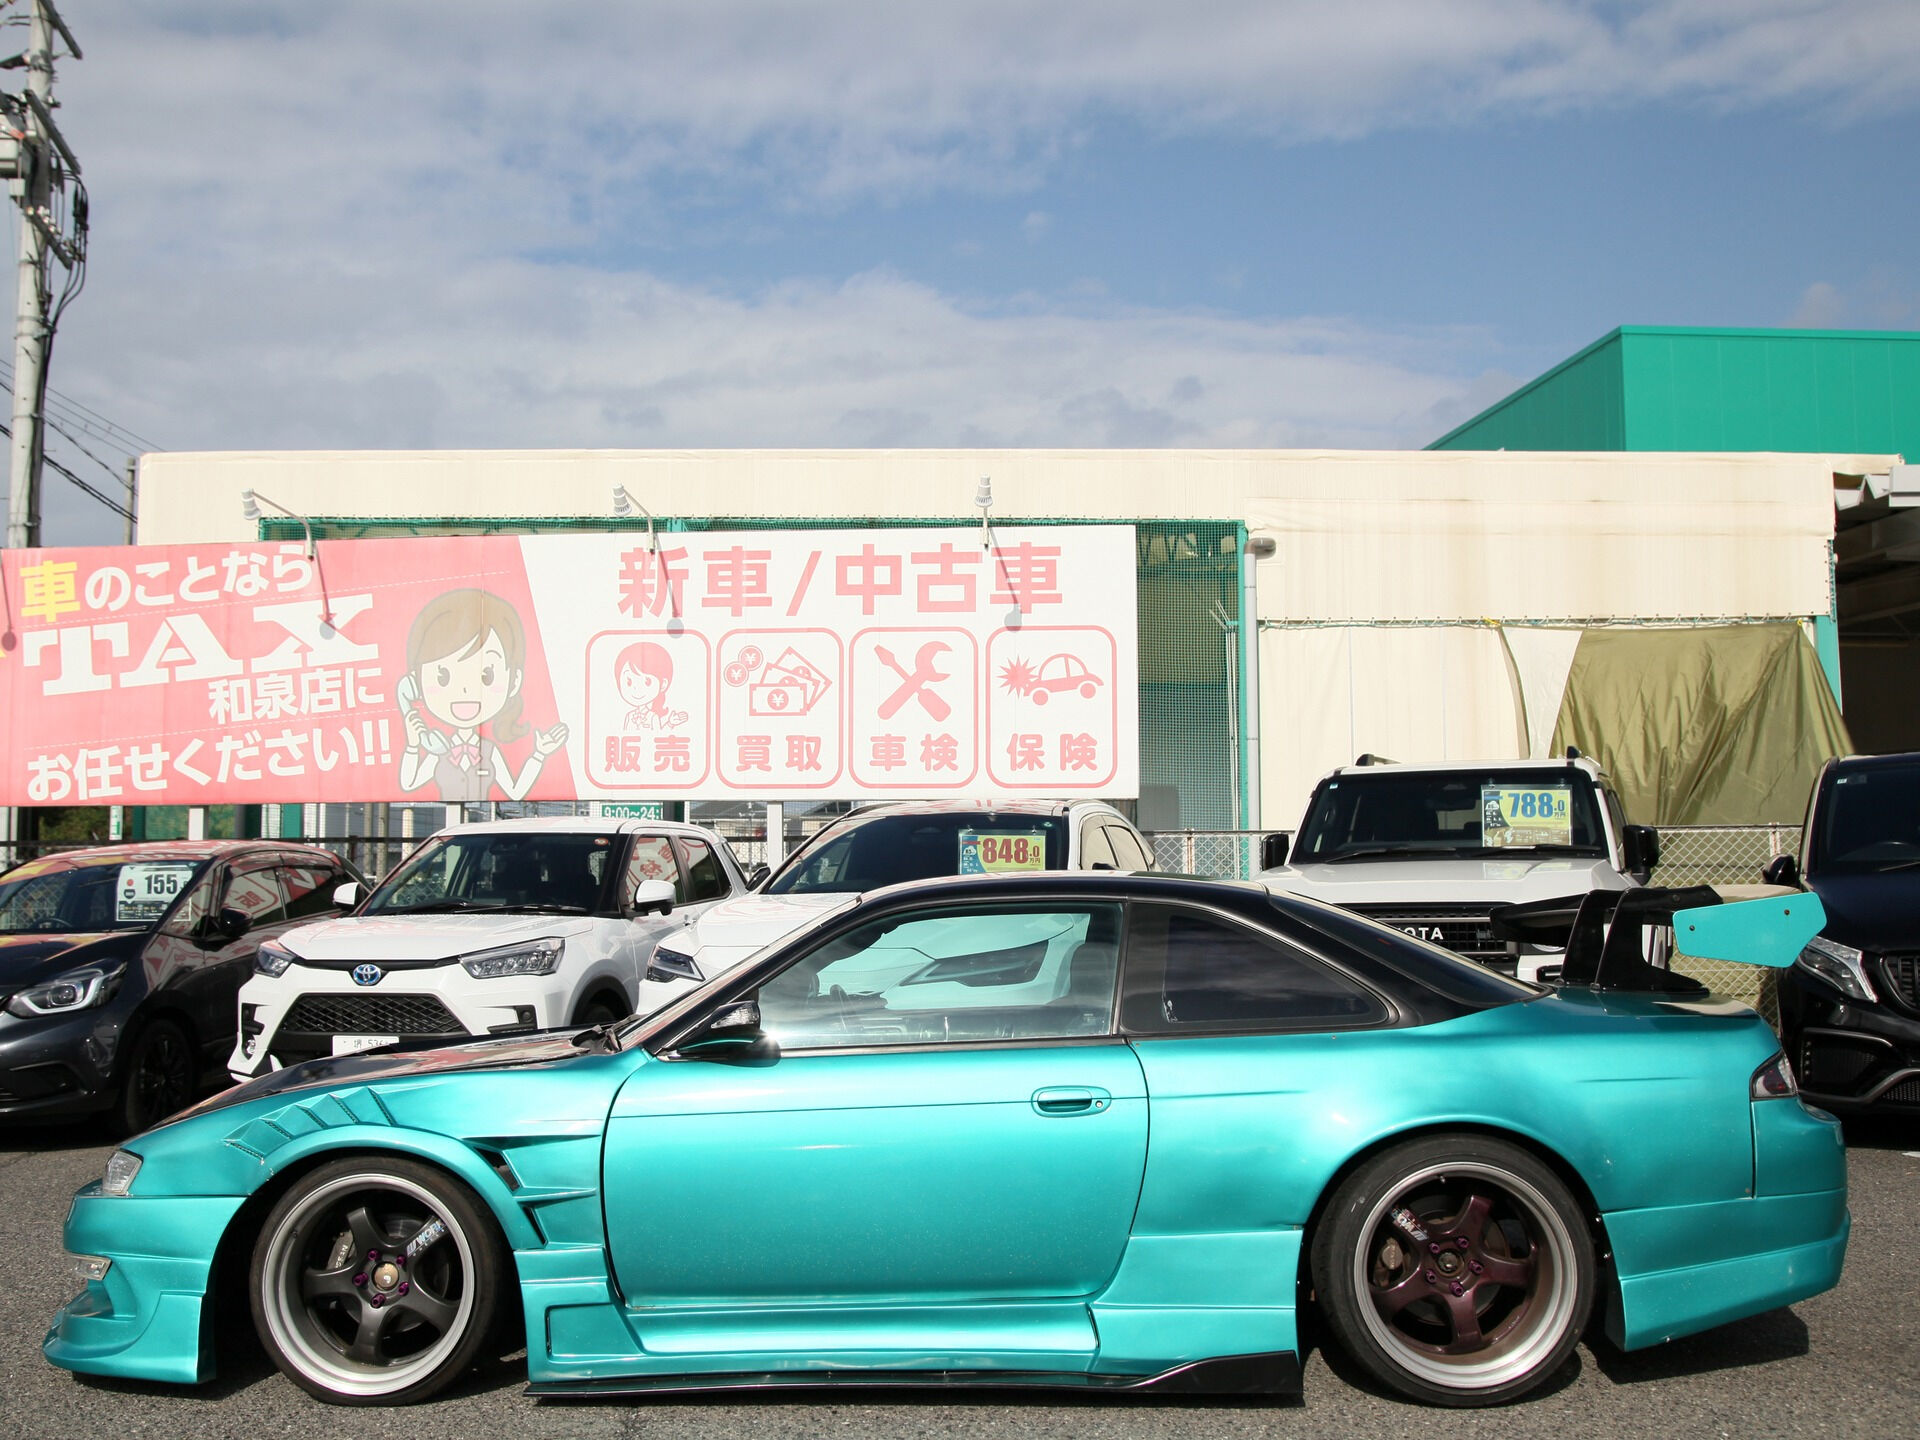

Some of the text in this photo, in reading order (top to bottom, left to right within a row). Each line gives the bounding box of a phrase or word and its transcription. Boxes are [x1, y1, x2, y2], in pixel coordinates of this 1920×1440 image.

[19, 544, 313, 623] 車のことなら
[616, 541, 1063, 619] 新車/中古車
[22, 593, 379, 697] TAX
[208, 667, 385, 725] 和泉店に
[27, 720, 392, 801] お任せください!!
[604, 734, 691, 772] 販売
[735, 734, 822, 772] 買取
[869, 733, 960, 771] 車検
[1005, 732, 1098, 771] 保険
[604, 806, 664, 820] 9:00~24:
[982, 837, 1040, 864] 848.0
[1396, 926, 1444, 940] OTA
